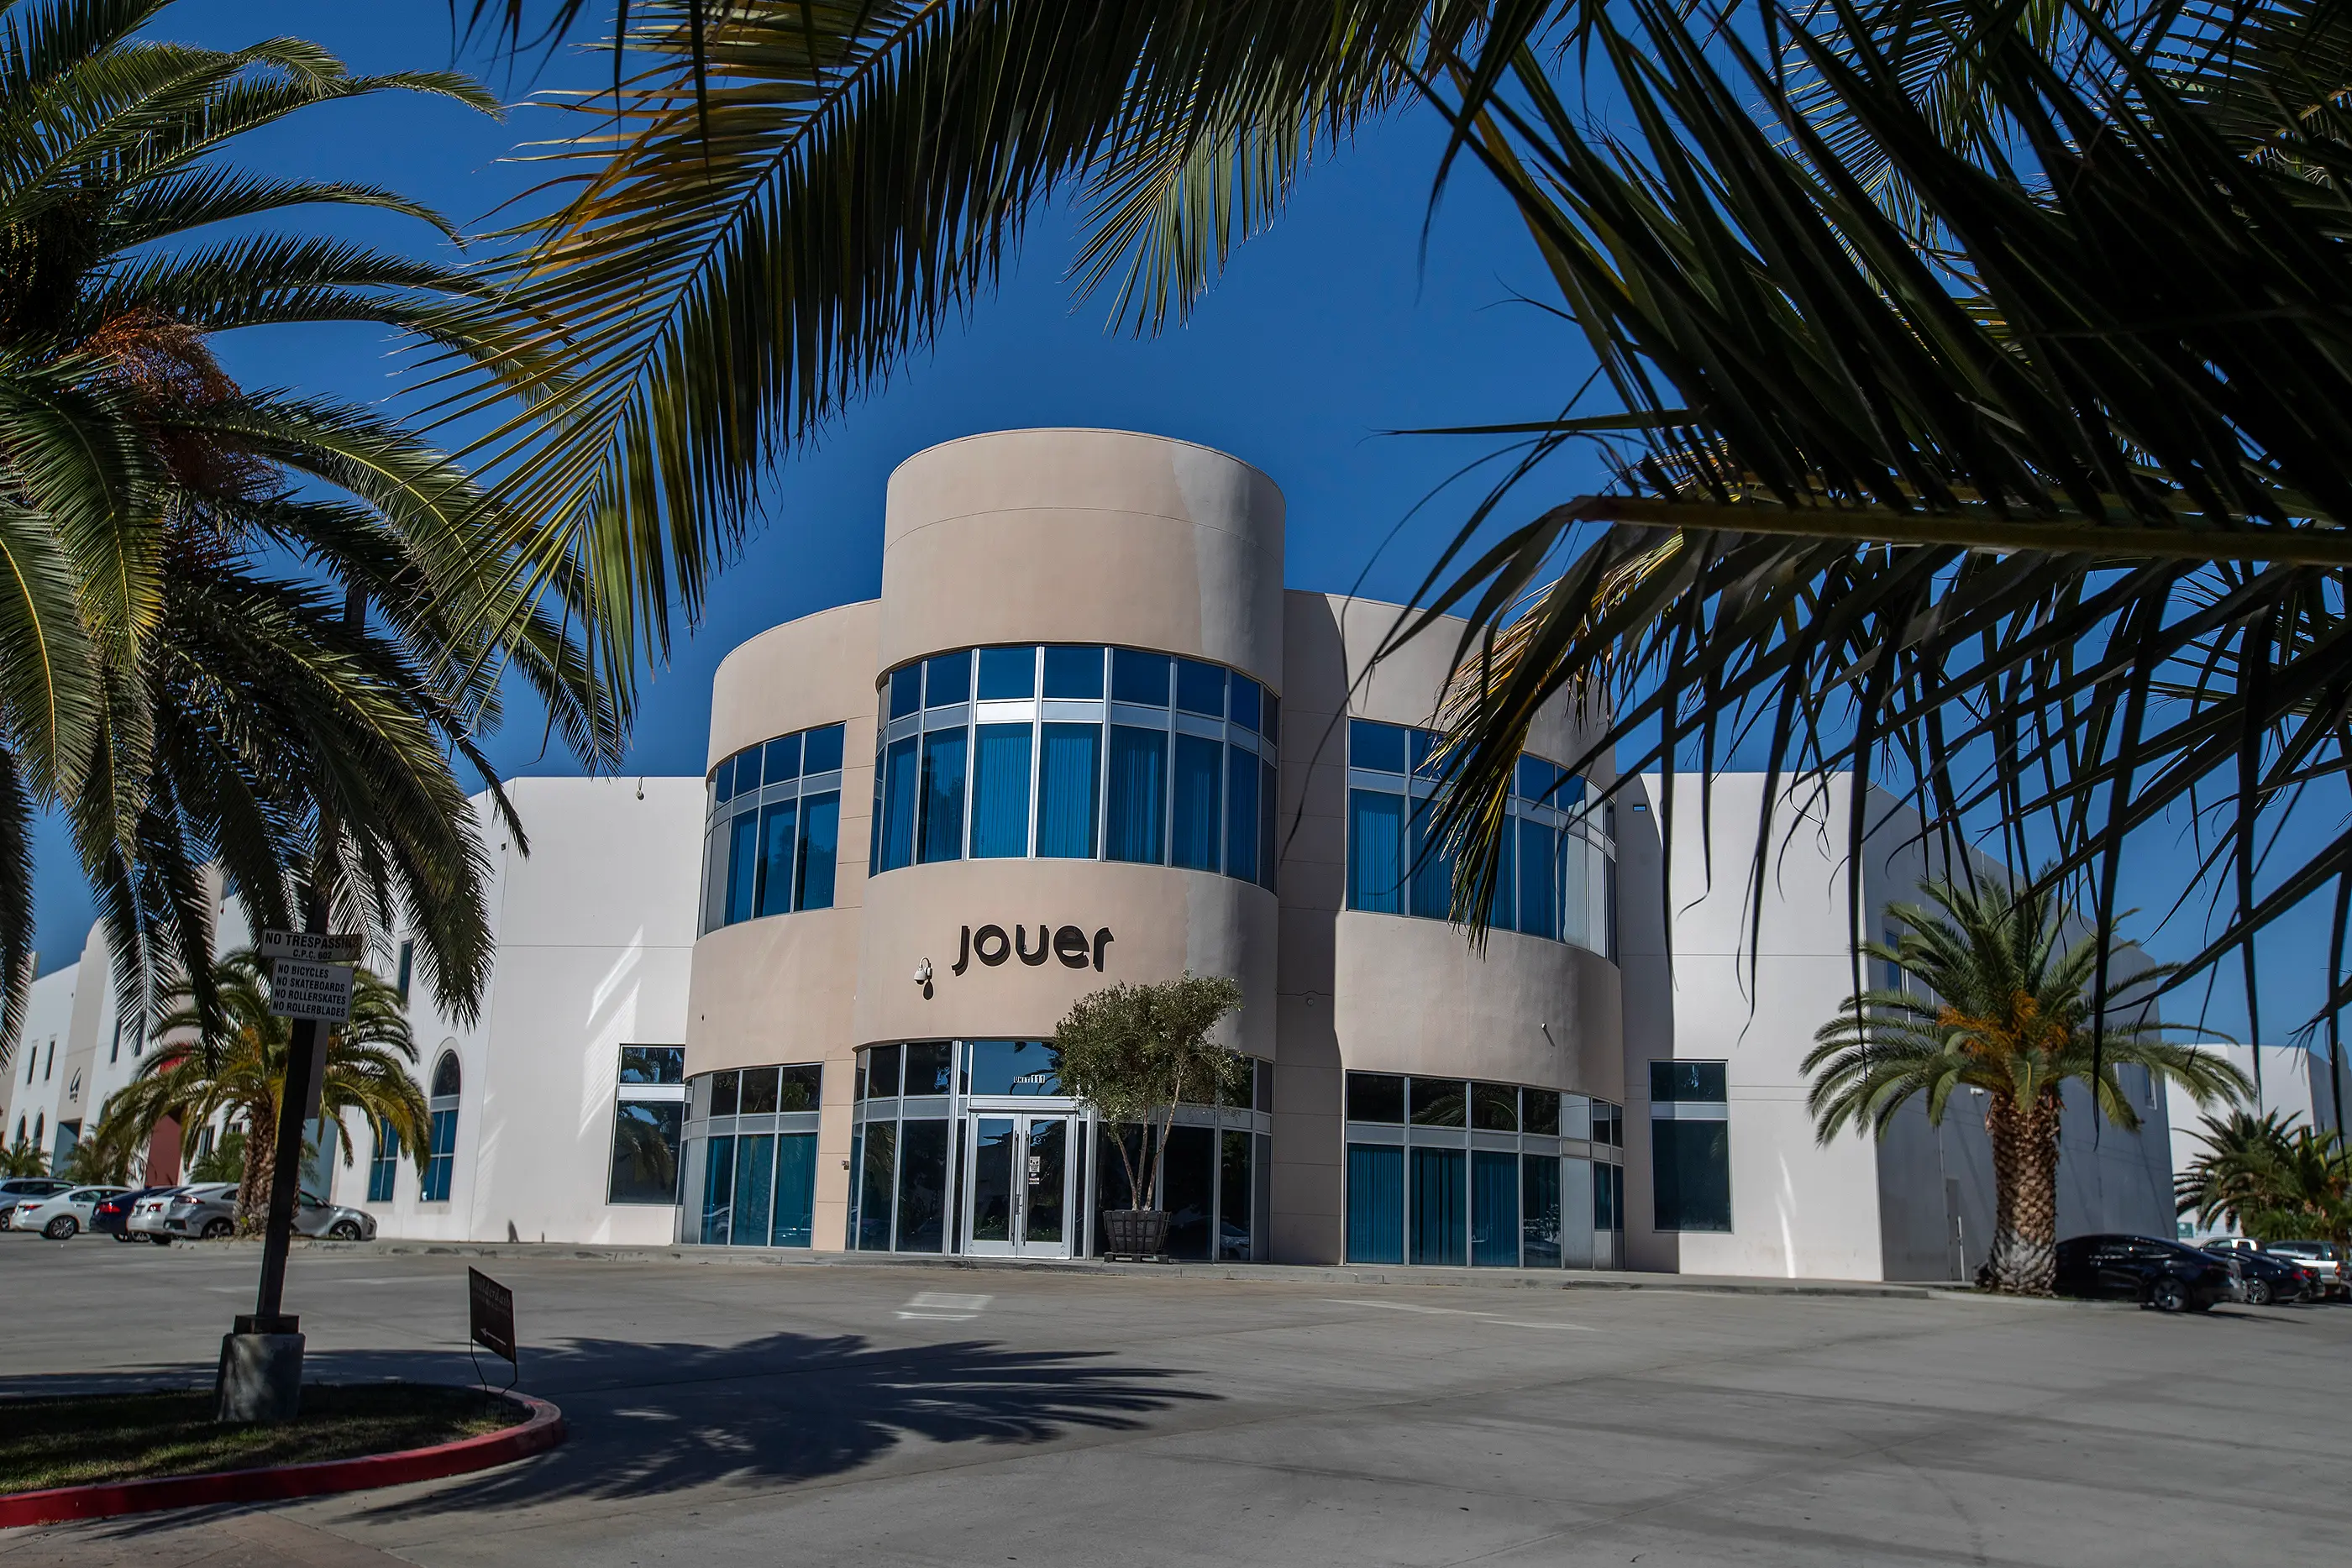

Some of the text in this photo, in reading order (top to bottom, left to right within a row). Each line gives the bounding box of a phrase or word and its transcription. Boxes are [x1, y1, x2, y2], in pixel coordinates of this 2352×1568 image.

[265, 932, 281, 945] NO
[318, 952, 332, 960] 602
[951, 924, 1115, 977] jouer
[278, 964, 328, 979] NO BICYCLES
[276, 976, 345, 993] NO SKATEBOARDS
[275, 989, 346, 1004] NO ROLLERSKATES
[273, 1001, 345, 1017] NO ROLLERBLADES
[1032, 1075, 1045, 1083] 111
